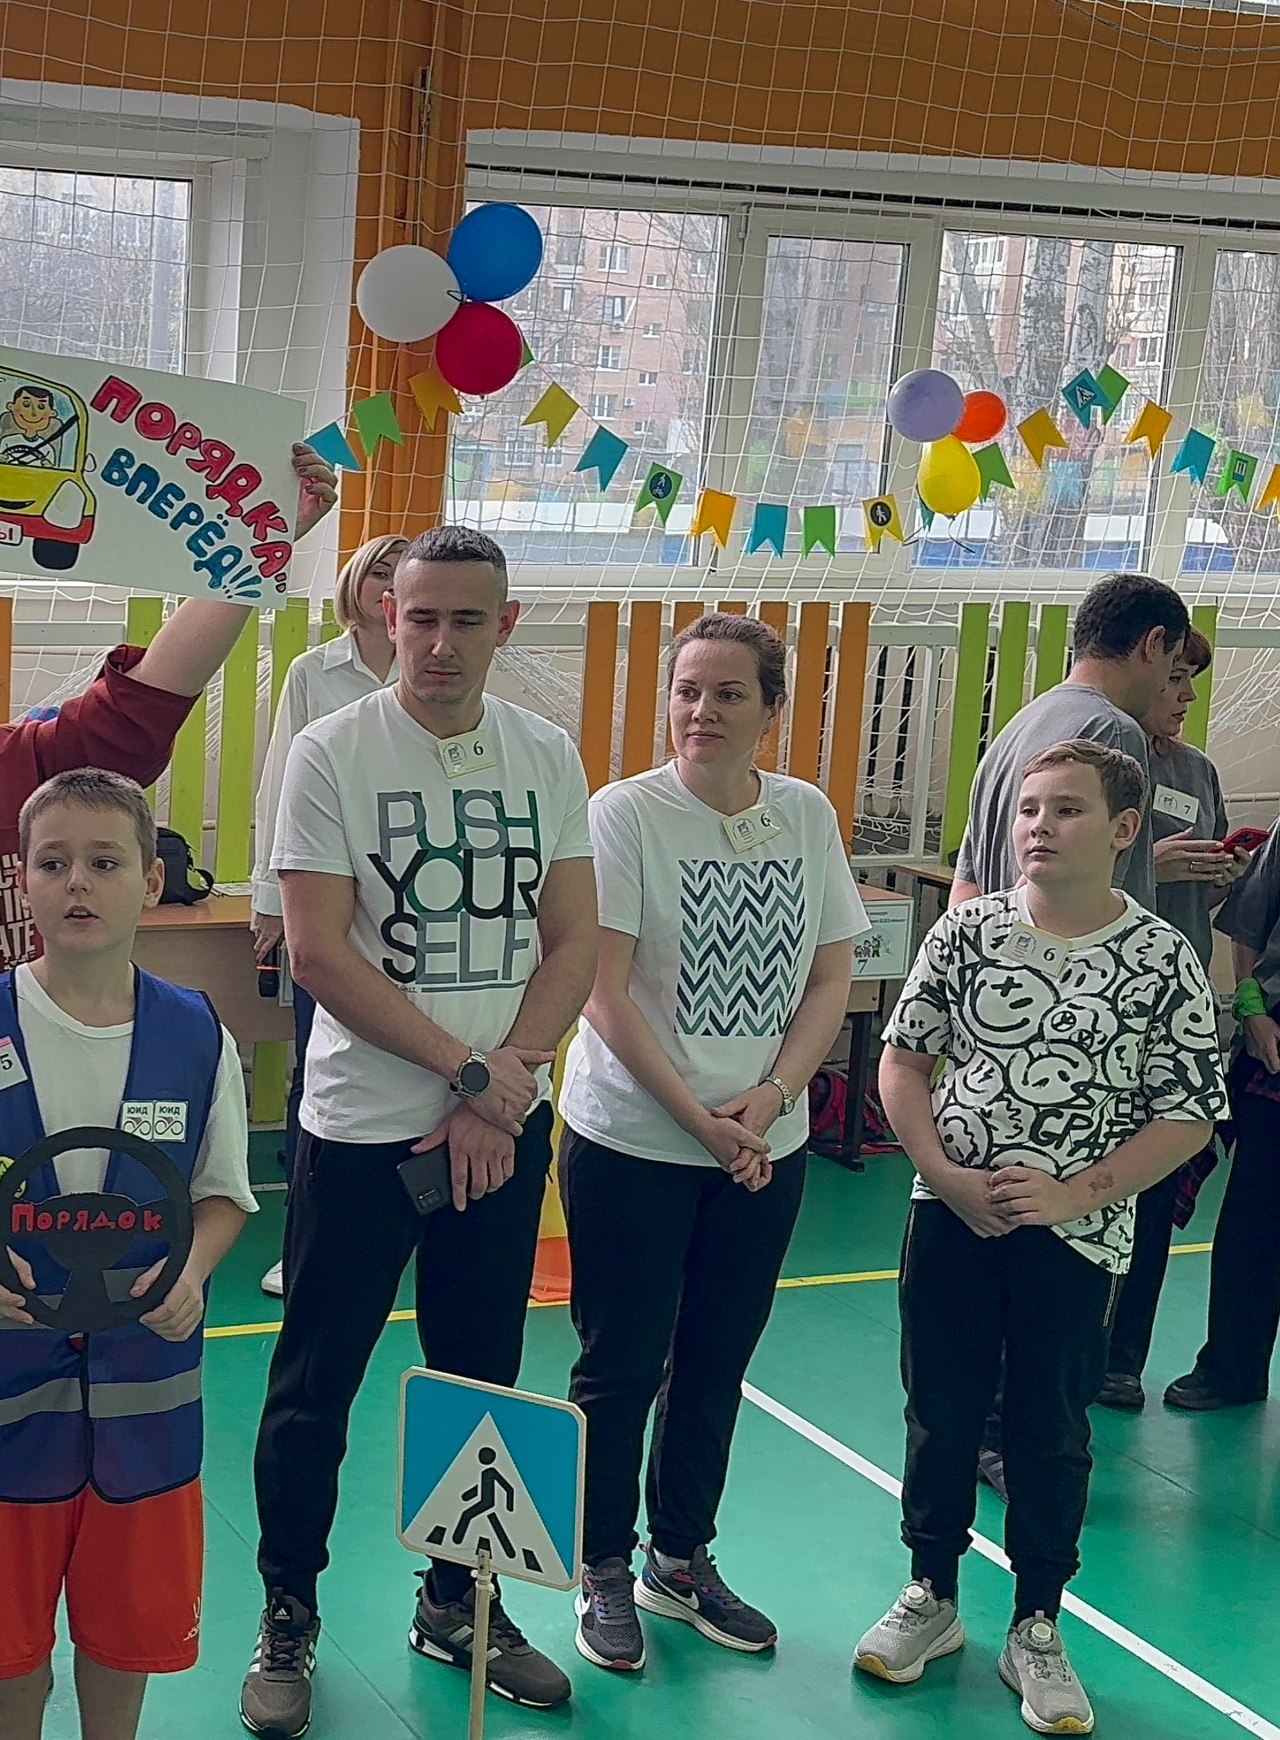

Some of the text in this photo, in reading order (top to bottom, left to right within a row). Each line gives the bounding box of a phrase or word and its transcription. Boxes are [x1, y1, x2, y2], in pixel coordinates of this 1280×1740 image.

[473, 740, 484, 756] 6
[1183, 804, 1192, 815] 7
[376, 789, 542, 864] PUSH
[366, 848, 543, 920] YOUR
[380, 909, 538, 985] SELF
[1043, 947, 1057, 962] 6
[857, 959, 869, 974] 7
[0, 1053, 13, 1070] 5
[127, 1106, 148, 1116] ЮИД
[159, 1106, 181, 1116] ЮИД
